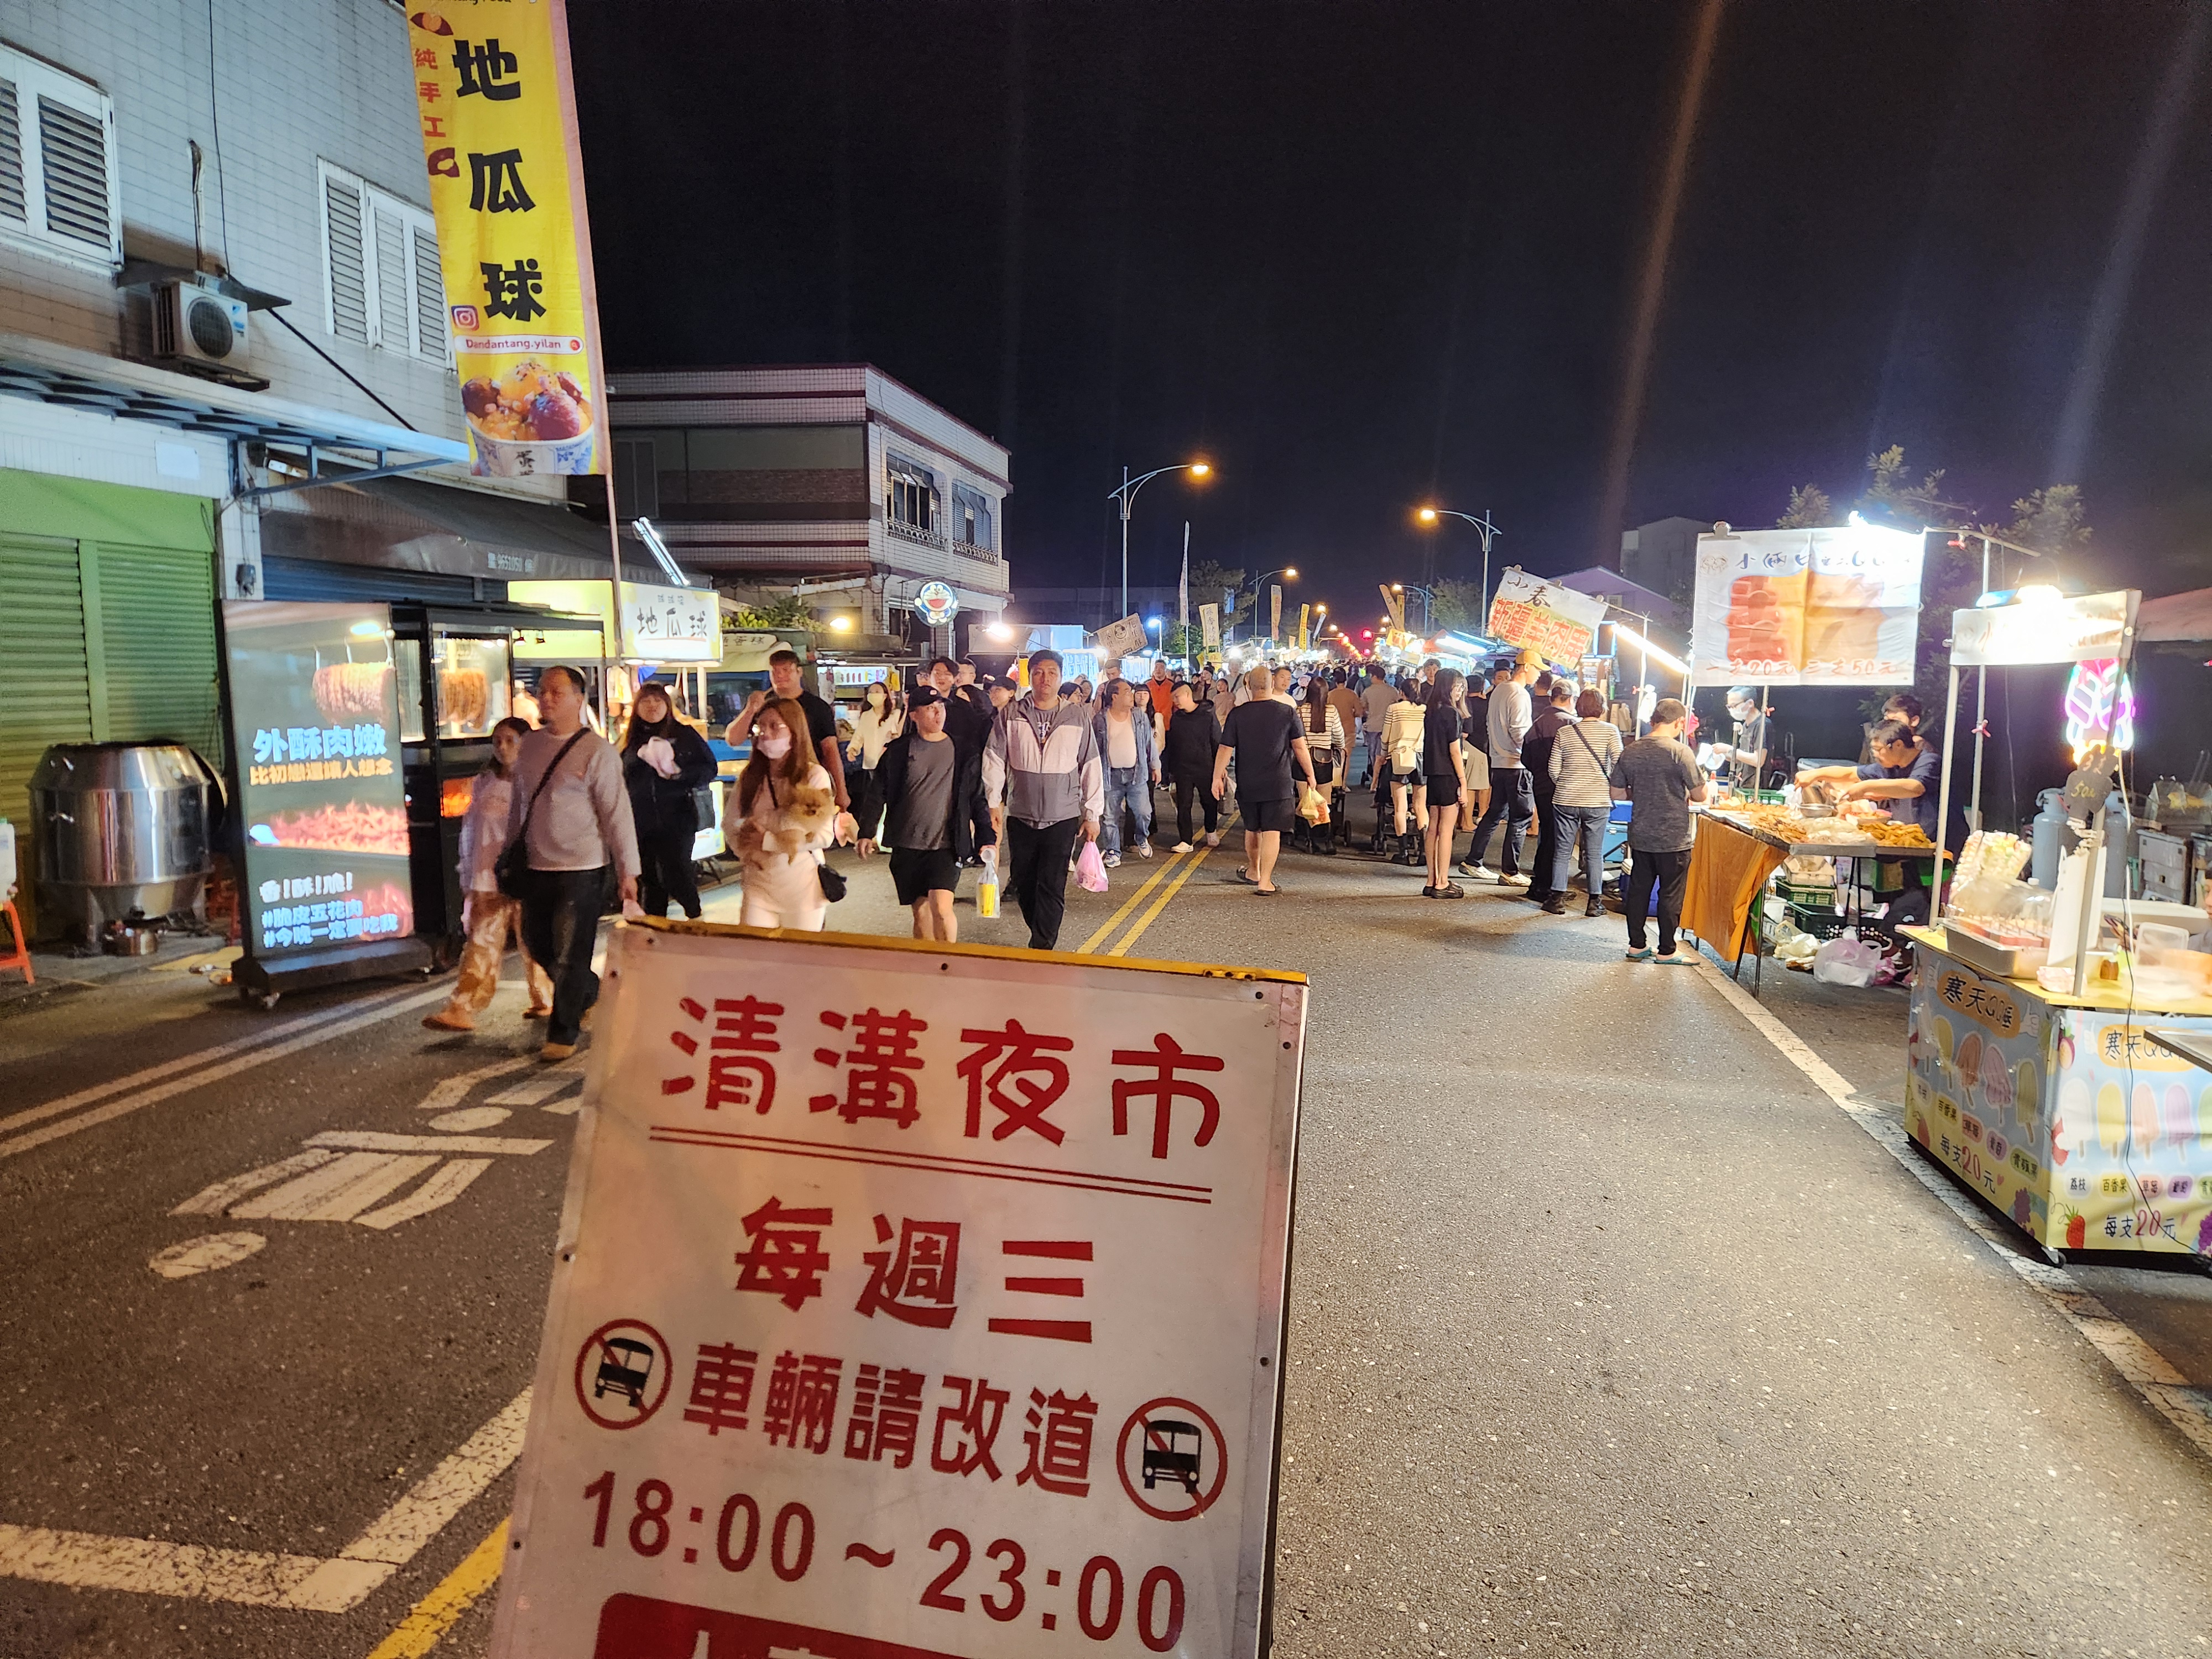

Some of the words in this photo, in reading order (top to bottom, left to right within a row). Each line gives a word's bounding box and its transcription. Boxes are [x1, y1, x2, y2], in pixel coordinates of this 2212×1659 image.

[415, 48, 446, 138] 純手工
[452, 38, 546, 322] 地瓜球
[466, 339, 561, 349] Dandantang.yilan
[1507, 577, 1551, 608] 小春
[637, 606, 707, 638] 地瓜球
[1490, 597, 1590, 664] 新疆羊肉串
[1706, 660, 1796, 676] 一支20元
[253, 723, 387, 763] 外酥肉嫩
[661, 995, 1224, 1159] 清溝夜市
[1940, 1133, 1996, 1194] 每支20元
[2103, 1178, 2128, 1193] 百香果
[2142, 1180, 2158, 1193] 草莓
[2201, 1180, 2212, 1196] 青
[2104, 1209, 2176, 1239] 每支20元
[735, 1196, 1094, 1344] 每週三
[684, 1343, 1098, 1498] 車輛請改道
[584, 1472, 815, 1582] 18:00
[920, 1528, 1184, 1652] 23:00
